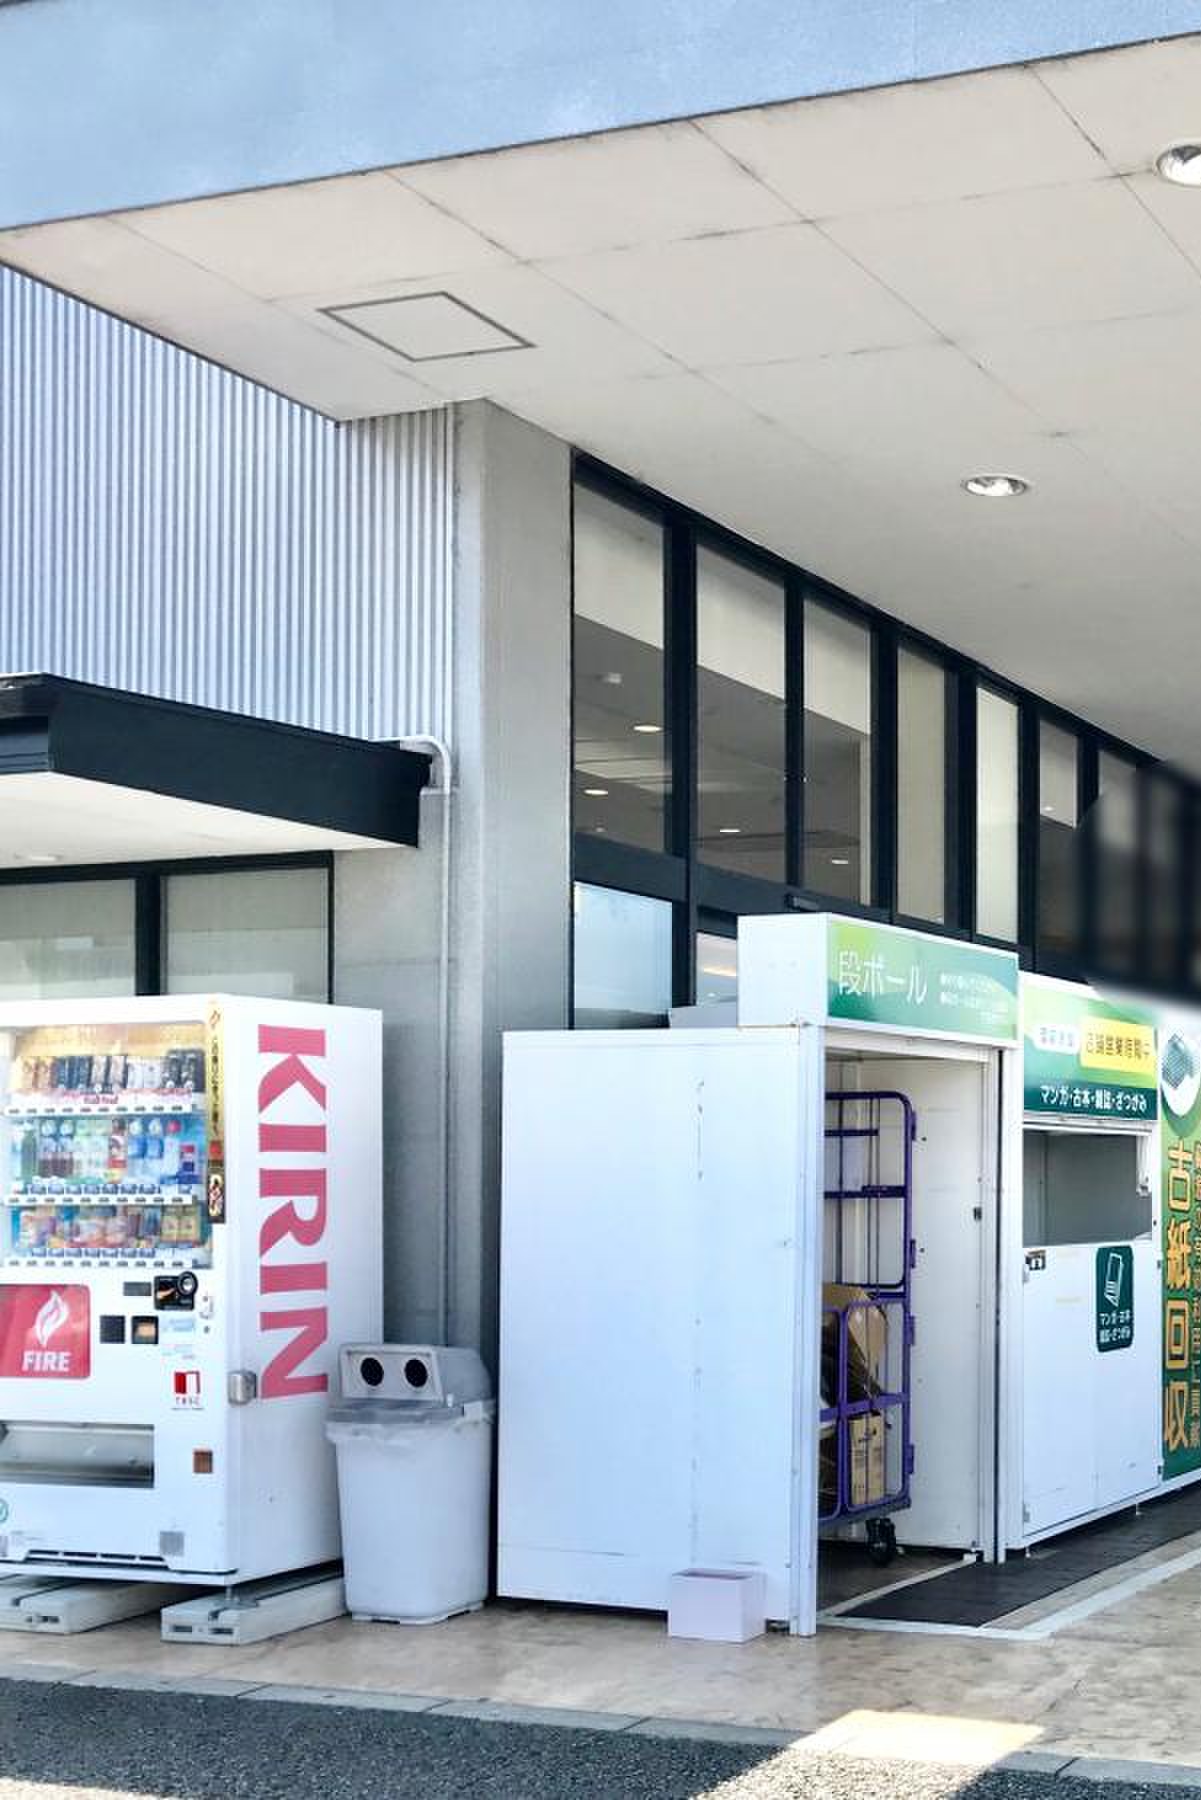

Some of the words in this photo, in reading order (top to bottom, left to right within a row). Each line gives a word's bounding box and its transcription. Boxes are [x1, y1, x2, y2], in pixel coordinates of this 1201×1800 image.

[839, 950, 928, 1005] 段ボール
[258, 1024, 329, 1400] KIRIN
[1164, 1138, 1193, 1452] 古紙回収
[22, 1351, 72, 1372] FIRE
